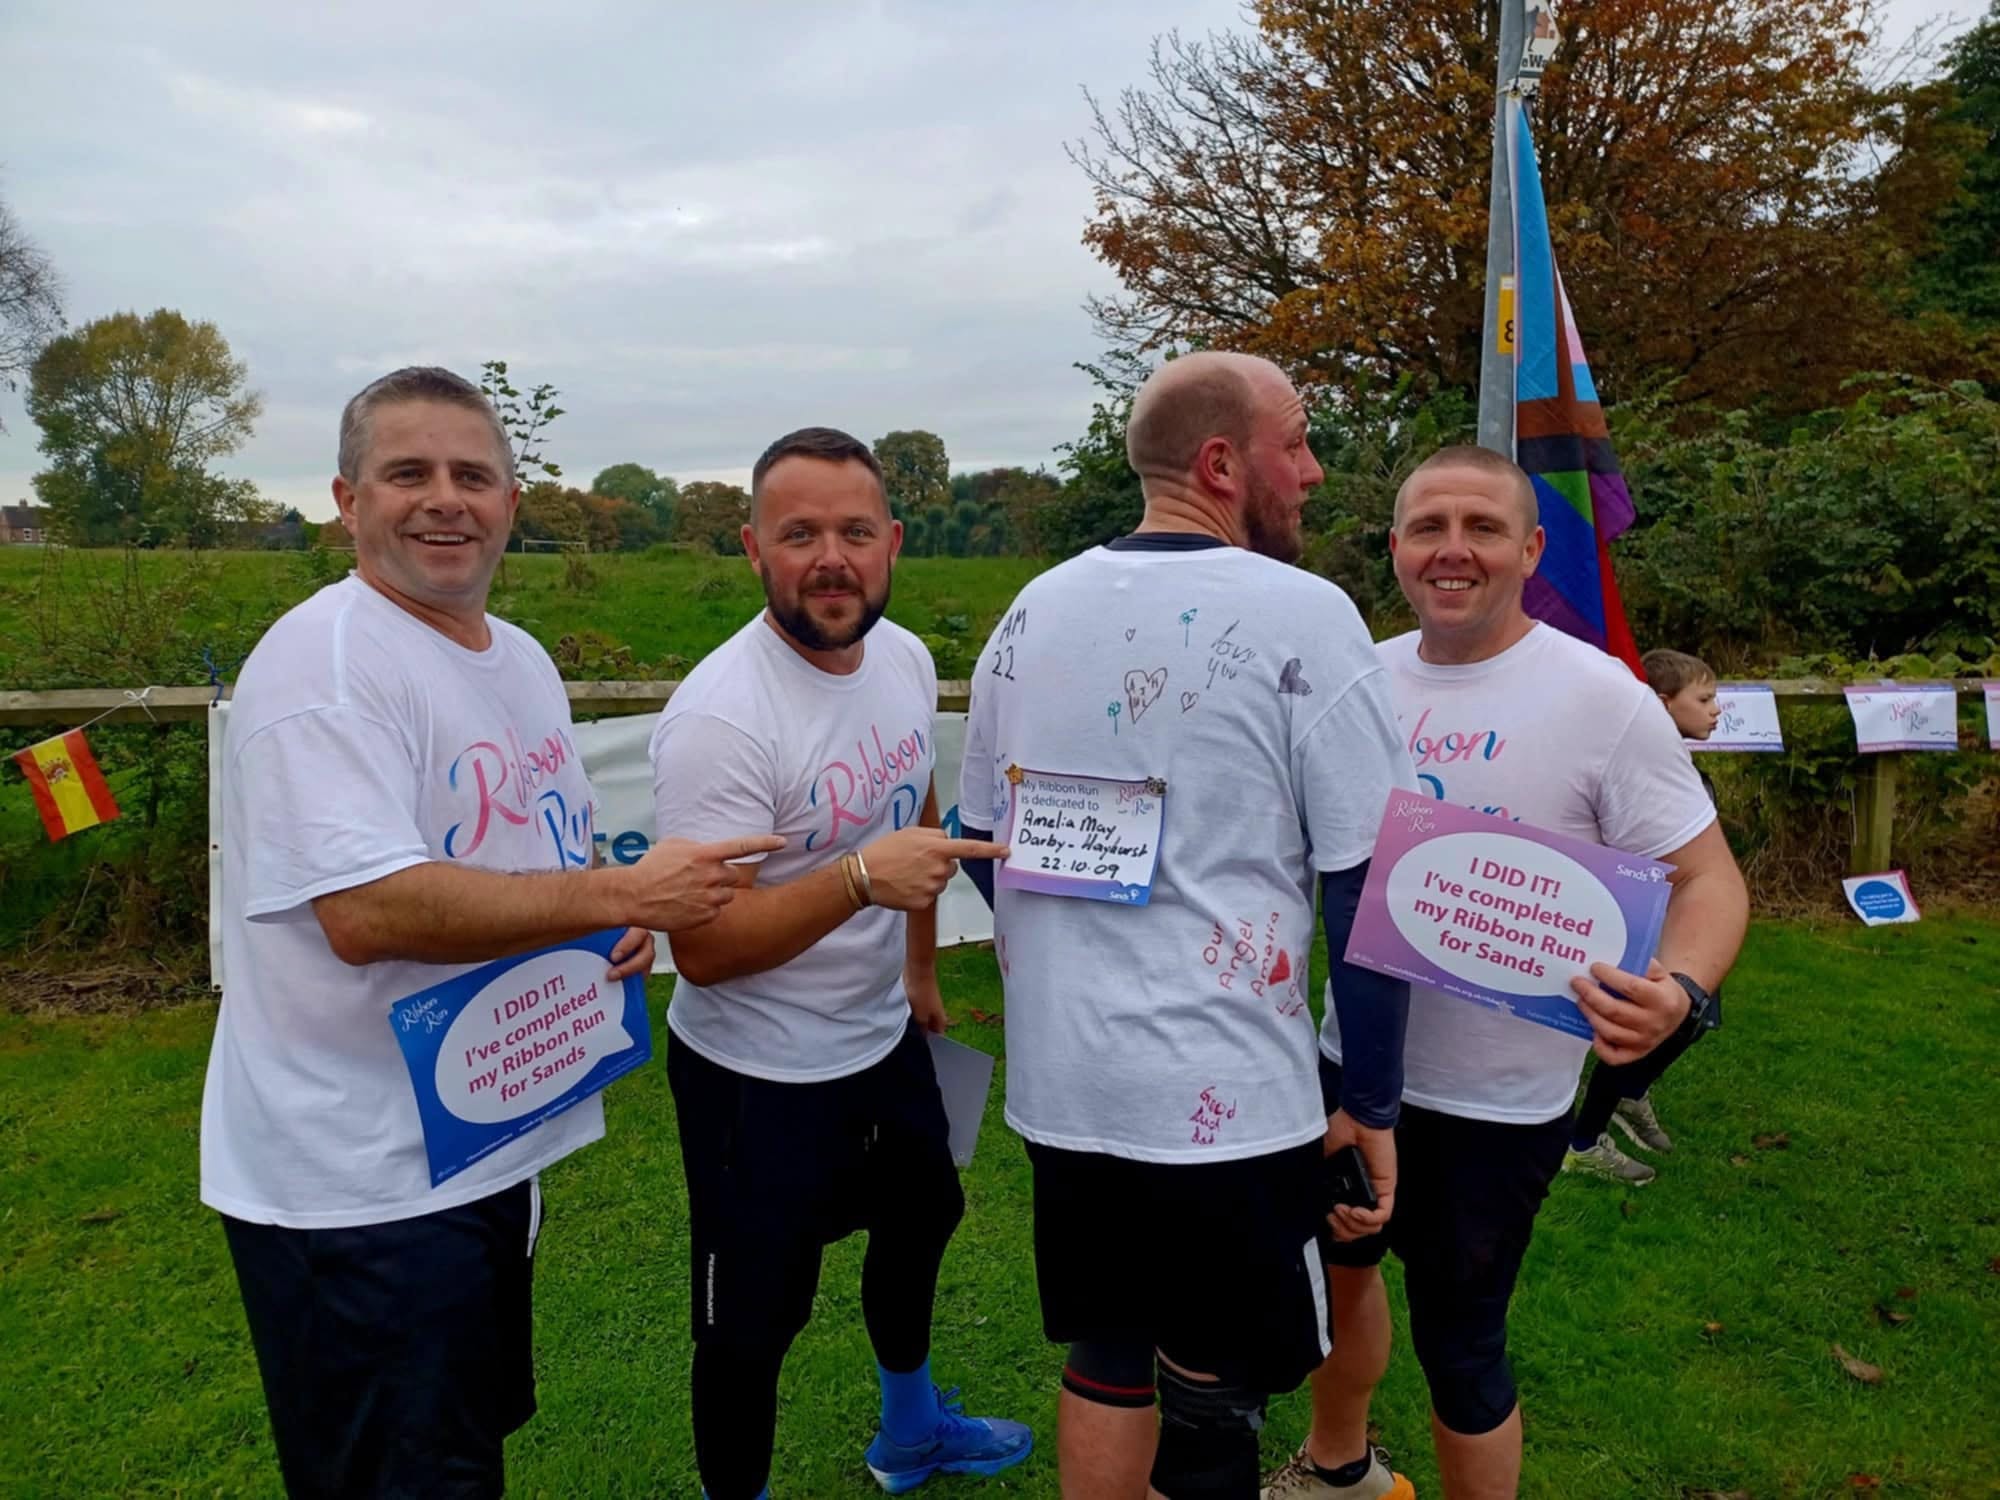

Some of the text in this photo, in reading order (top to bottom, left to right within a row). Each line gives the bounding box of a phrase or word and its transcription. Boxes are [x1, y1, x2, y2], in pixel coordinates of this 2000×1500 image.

[999, 611, 1026, 645] AM
[992, 645, 1014, 680] 22
[807, 725, 926, 851] Ribbon
[1021, 780, 1099, 796] My Ribbon Run
[1021, 794, 1100, 812] is dedicated to
[1391, 799, 1433, 817] Ribbon
[1023, 808, 1117, 840] Amelia May
[1408, 814, 1436, 833] Run
[1469, 857, 1561, 899] I DID IT!
[1616, 863, 1649, 882] Sands
[1414, 899, 1586, 964] my Ribbon Run
[1468, 889, 1594, 937] completed
[1203, 920, 1226, 965] Our
[1219, 917, 1257, 991] Angel
[1439, 930, 1545, 978] for Sands
[398, 998, 438, 1032] Ribbon
[493, 974, 566, 1025] I DID IT!
[505, 981, 598, 1046] completed
[422, 1008, 448, 1034] Run
[468, 1067, 498, 1095] my
[502, 1030, 569, 1075] Ribbon
[572, 1009, 606, 1037] Run
[500, 1078, 528, 1103] for
[531, 1046, 587, 1085] Sands
